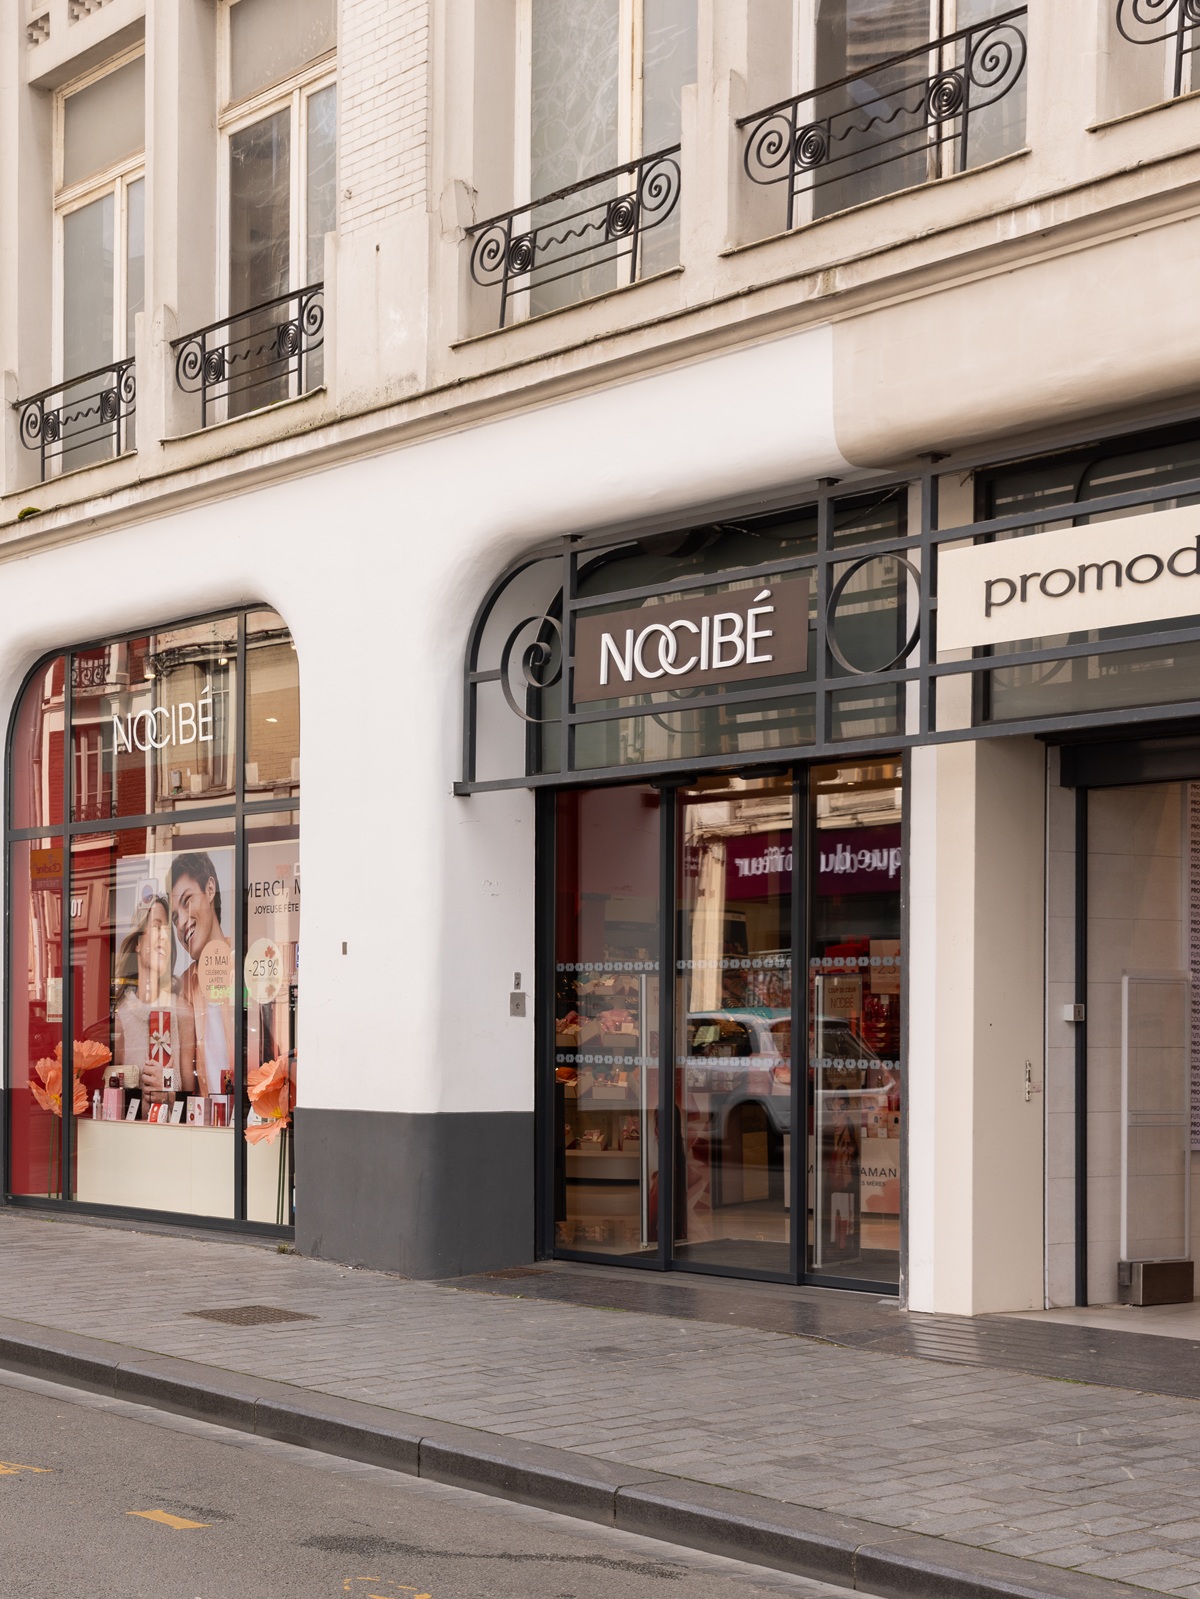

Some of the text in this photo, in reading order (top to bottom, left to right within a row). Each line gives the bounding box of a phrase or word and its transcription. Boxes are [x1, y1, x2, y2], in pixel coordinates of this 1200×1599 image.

[984, 534, 1200, 618] promod
[599, 588, 774, 687] NOCIBÉ
[112, 686, 214, 756] NOCIBÉ
[254, 904, 283, 915] JOYEUSE
[204, 956, 229, 967] 31 MAI
[860, 1167, 897, 1178] AMAN
